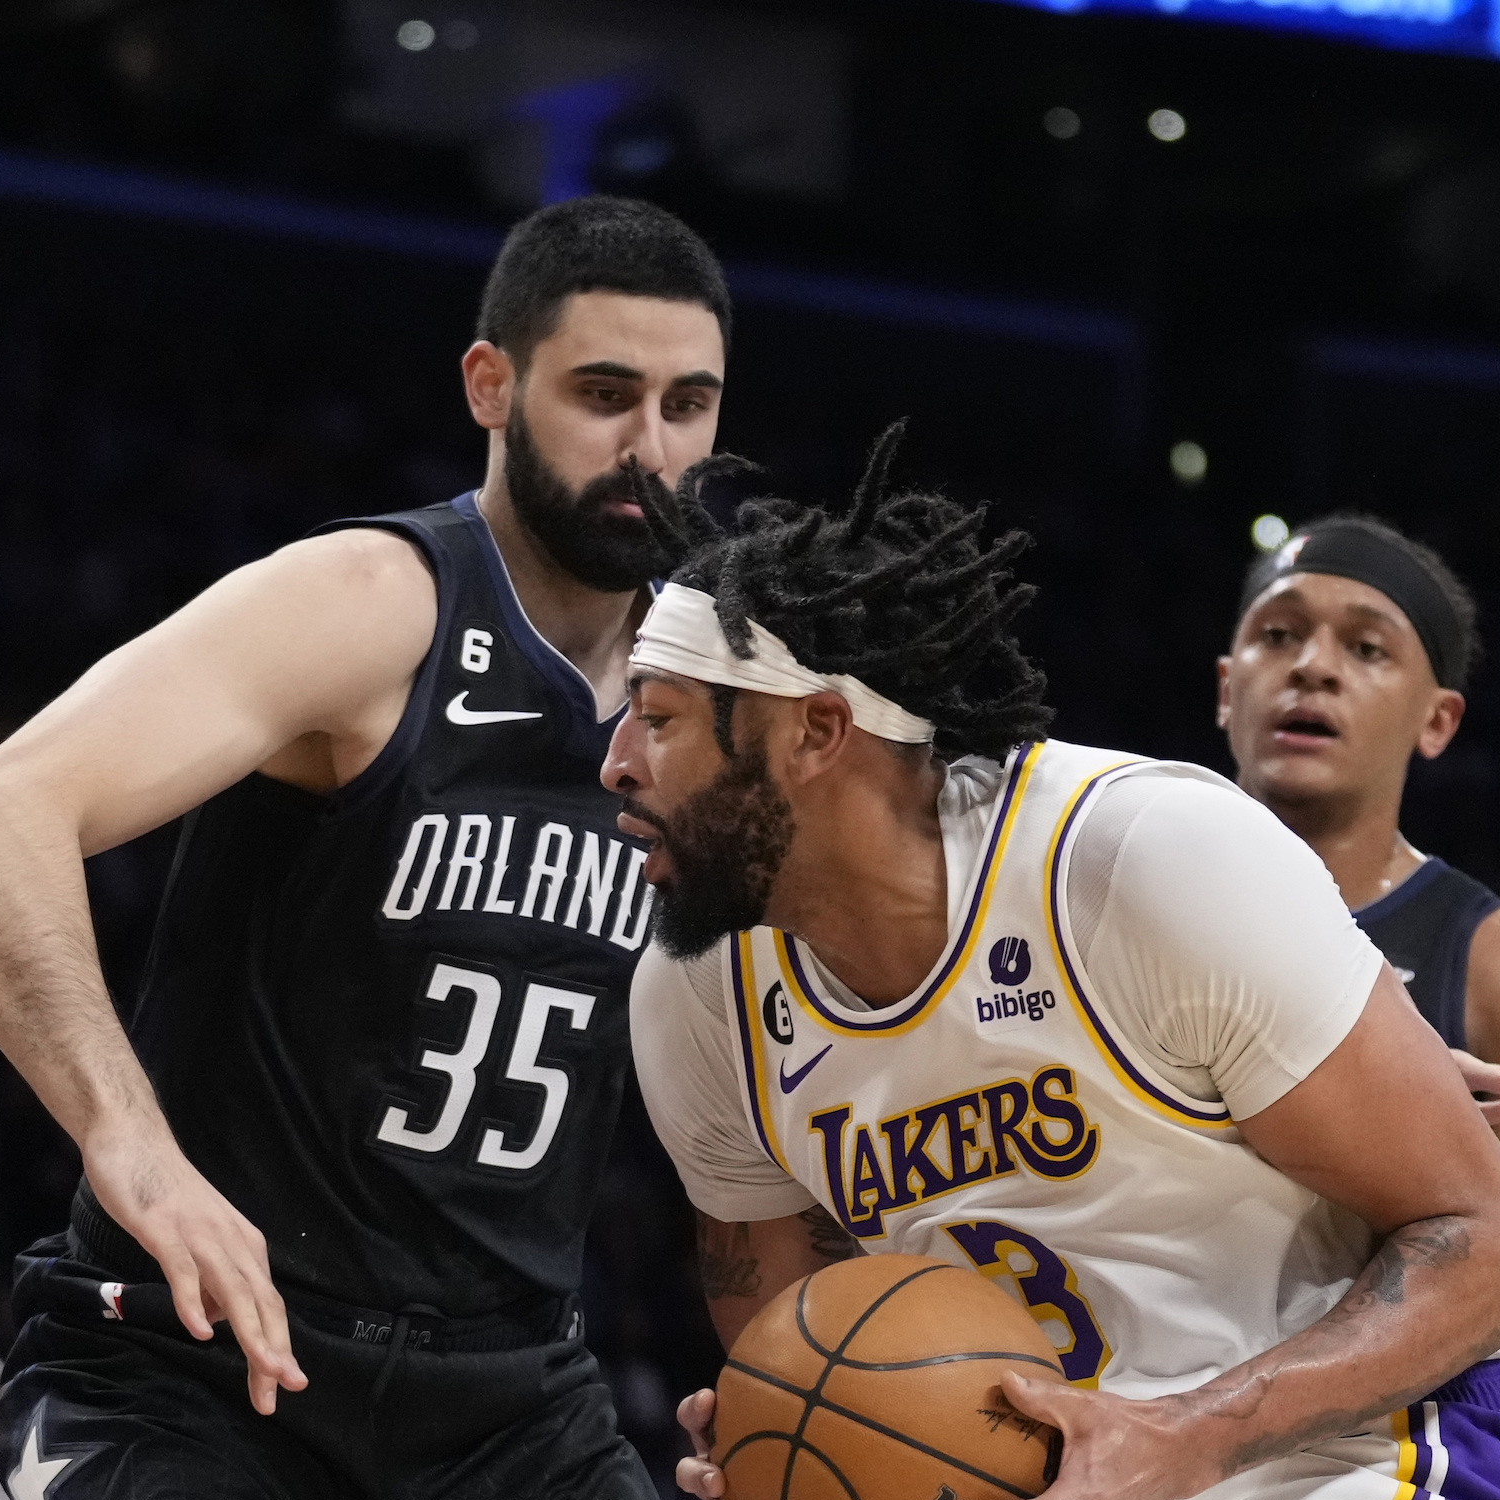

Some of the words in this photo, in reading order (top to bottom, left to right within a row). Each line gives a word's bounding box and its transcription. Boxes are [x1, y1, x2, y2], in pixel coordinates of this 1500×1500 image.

[460, 627, 495, 674] 6
[381, 812, 656, 952] ORLAND
[377, 962, 598, 1170] 35
[976, 988, 1057, 1022] bibigo
[808, 1063, 1101, 1240] LAKERS
[944, 1219, 1115, 1390] 3
